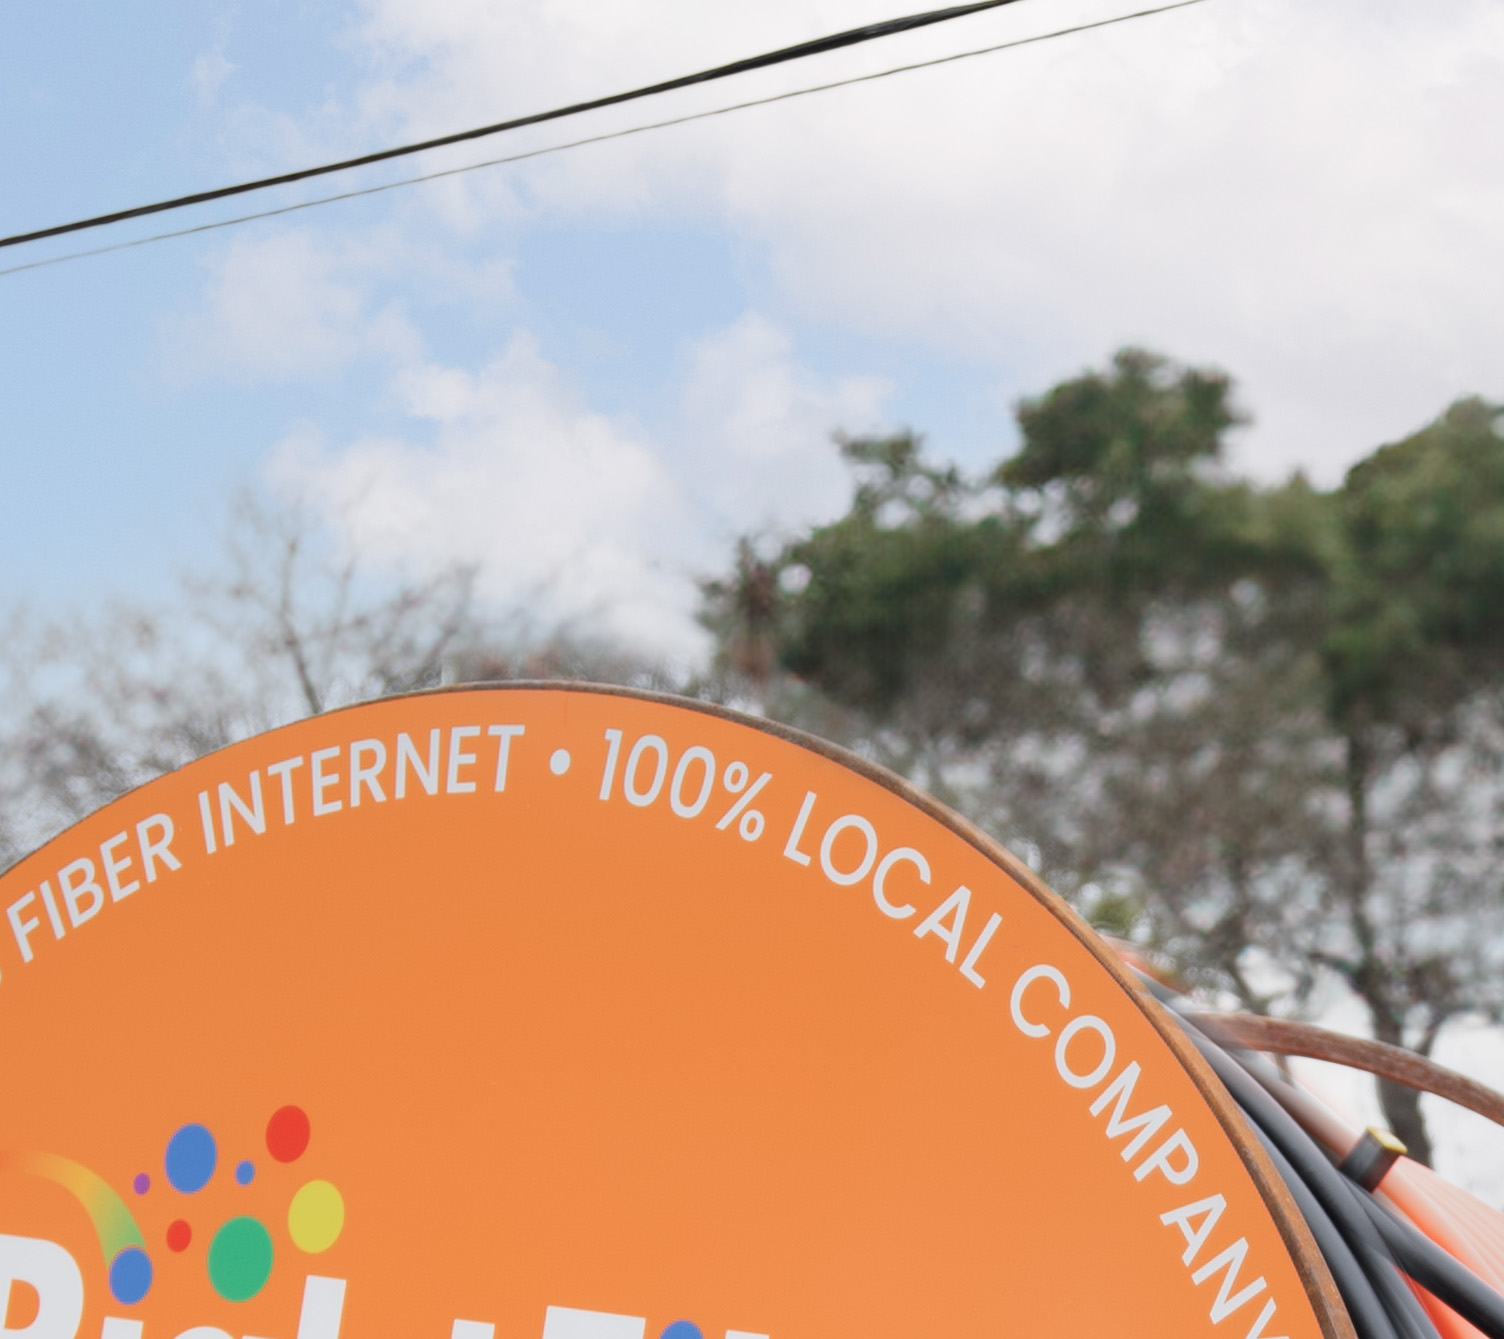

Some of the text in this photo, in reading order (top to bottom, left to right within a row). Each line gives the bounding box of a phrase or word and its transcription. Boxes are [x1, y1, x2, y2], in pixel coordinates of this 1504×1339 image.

[6, 813, 182, 963] FIBER
[198, 724, 526, 854] INTERNET
[599, 728, 773, 842] 100%
[783, 791, 1003, 989] LOCAL
